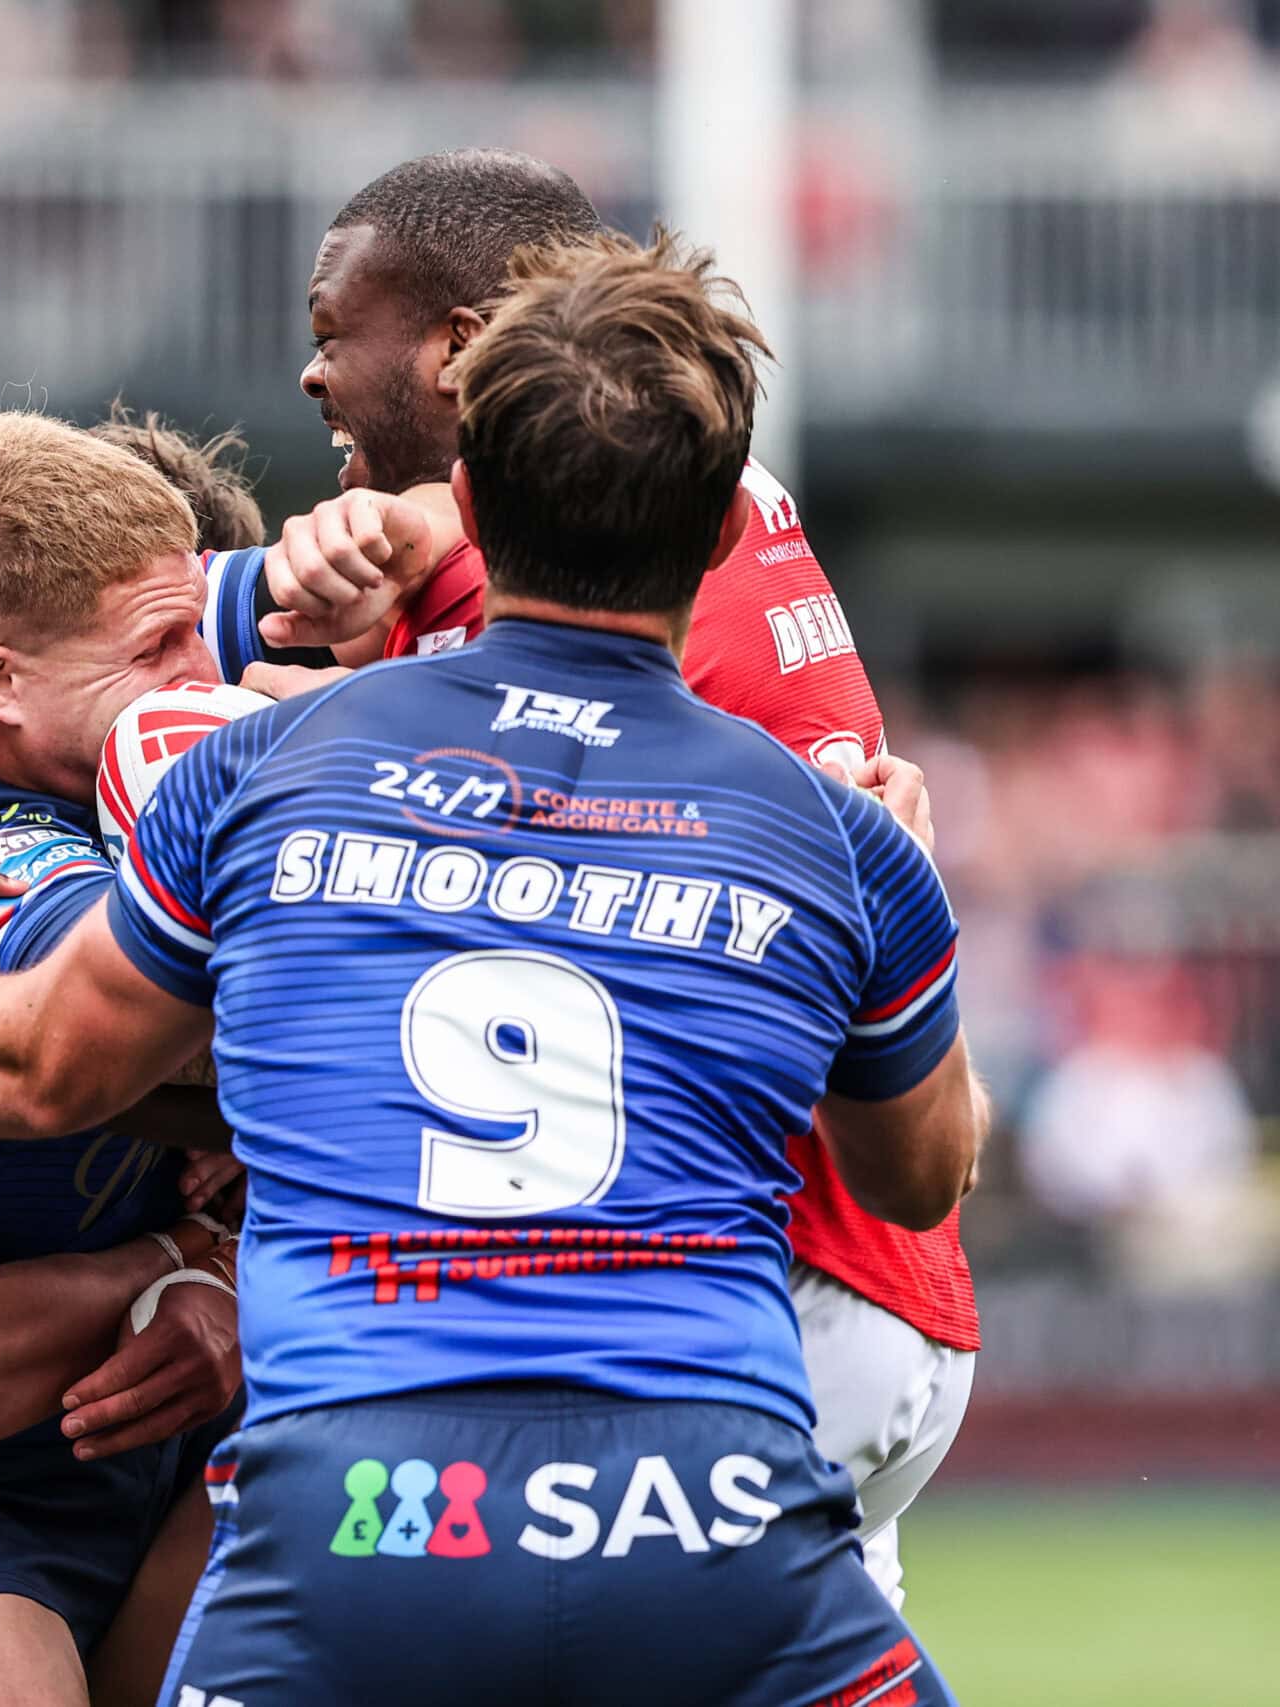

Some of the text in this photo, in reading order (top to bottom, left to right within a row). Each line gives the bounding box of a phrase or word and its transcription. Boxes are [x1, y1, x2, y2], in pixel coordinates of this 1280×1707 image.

[494, 683, 622, 738] TSL
[369, 761, 506, 819] 24/7
[533, 788, 701, 819] CONCRETE &
[529, 811, 710, 838] AGGREGATES
[270, 830, 793, 964] SMOOTHY
[400, 948, 624, 1218] 9
[517, 1453, 782, 1562] SAS
